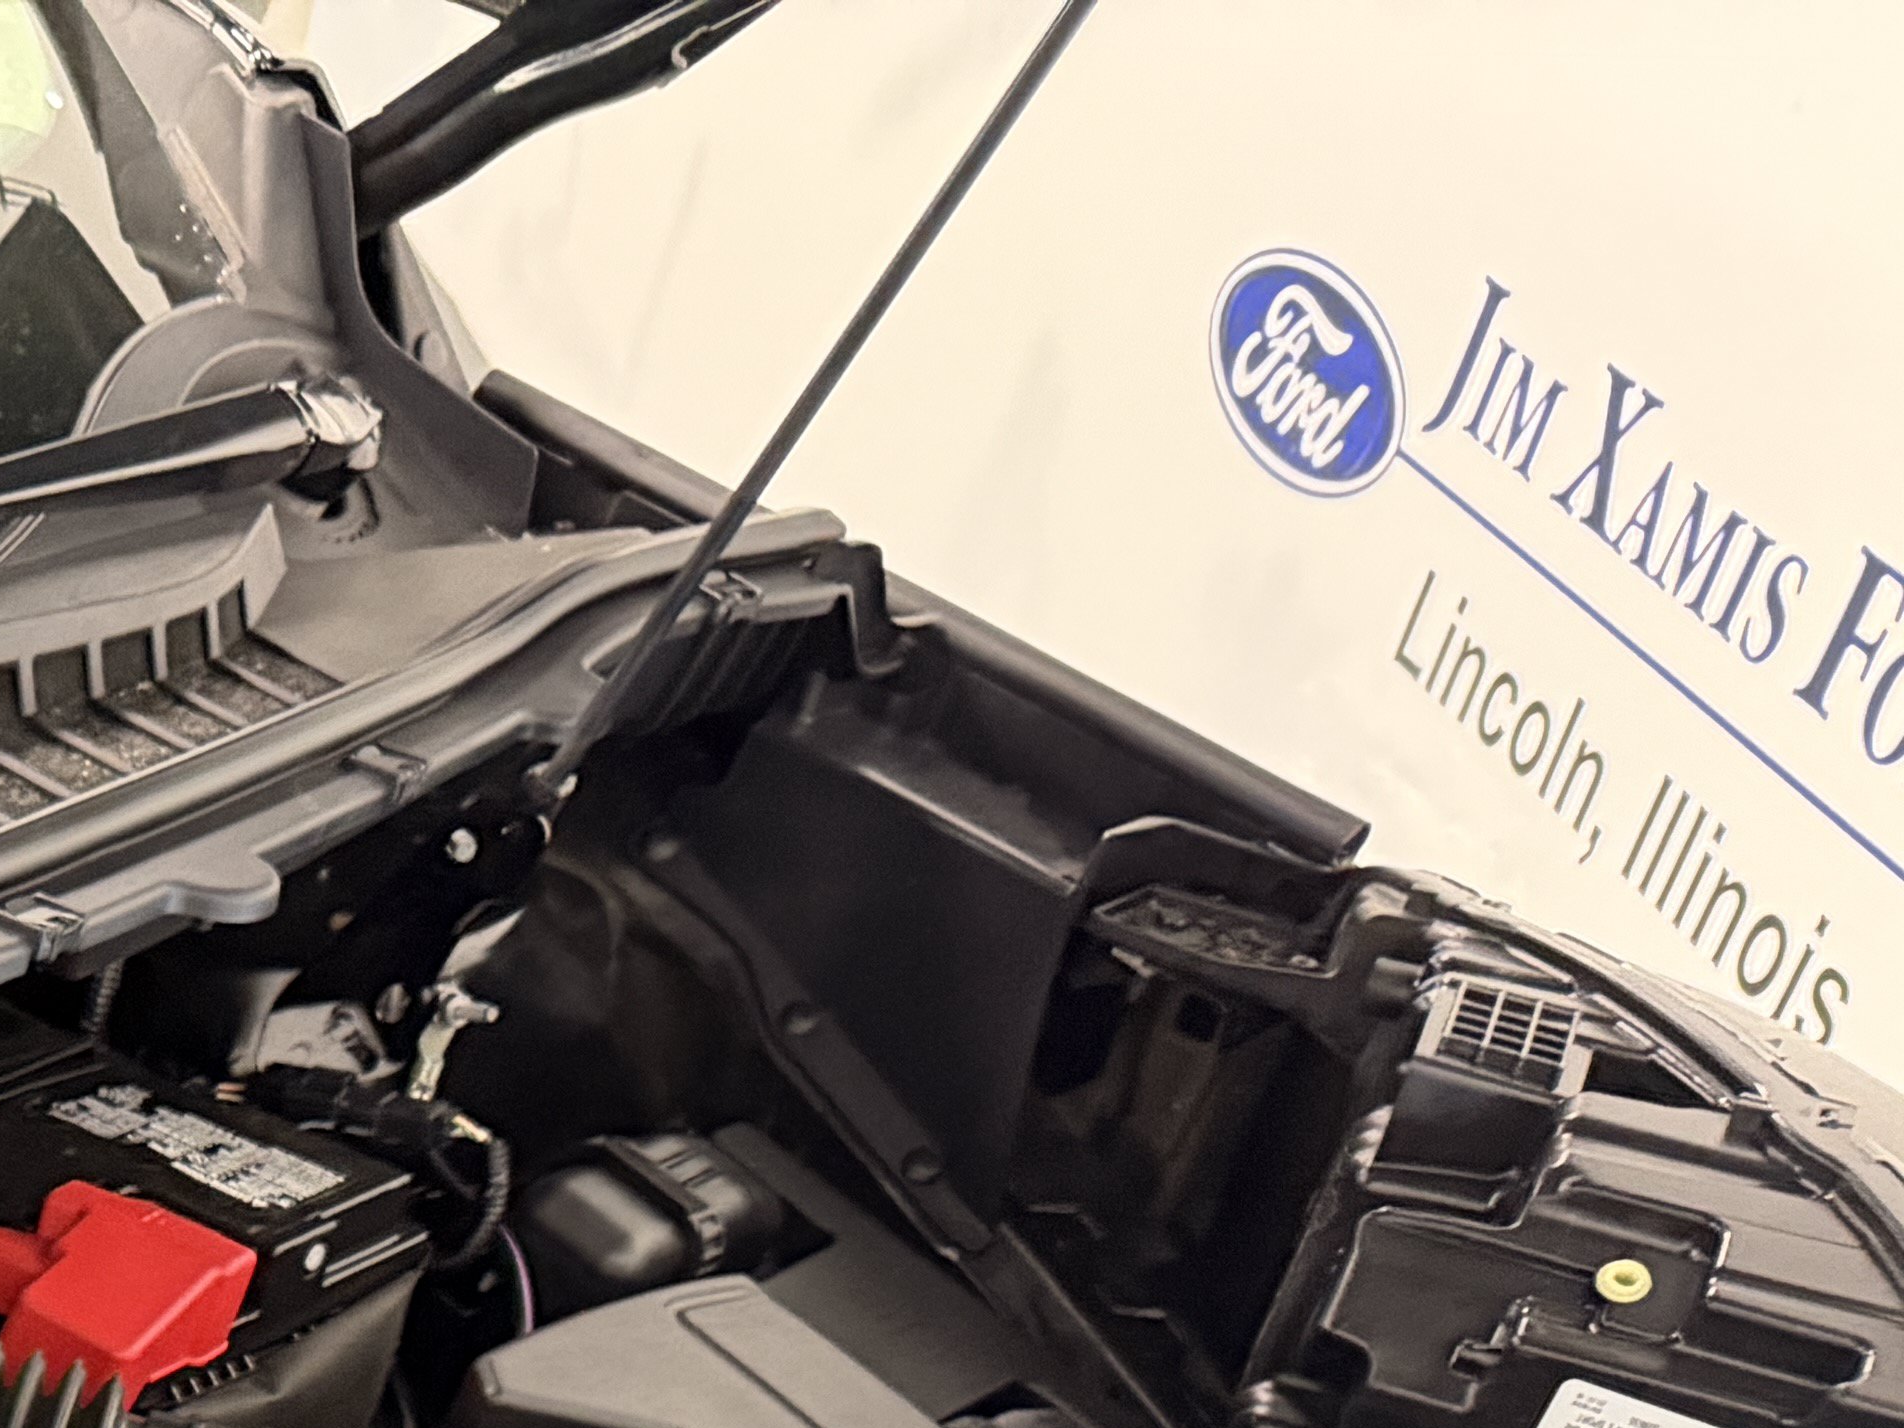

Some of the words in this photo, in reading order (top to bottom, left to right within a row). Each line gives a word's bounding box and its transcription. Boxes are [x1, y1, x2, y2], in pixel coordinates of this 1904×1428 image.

[1232, 284, 1371, 469] Ford
[1393, 568, 1607, 865] Lincoln,
[1620, 774, 1852, 1051] Illinois
